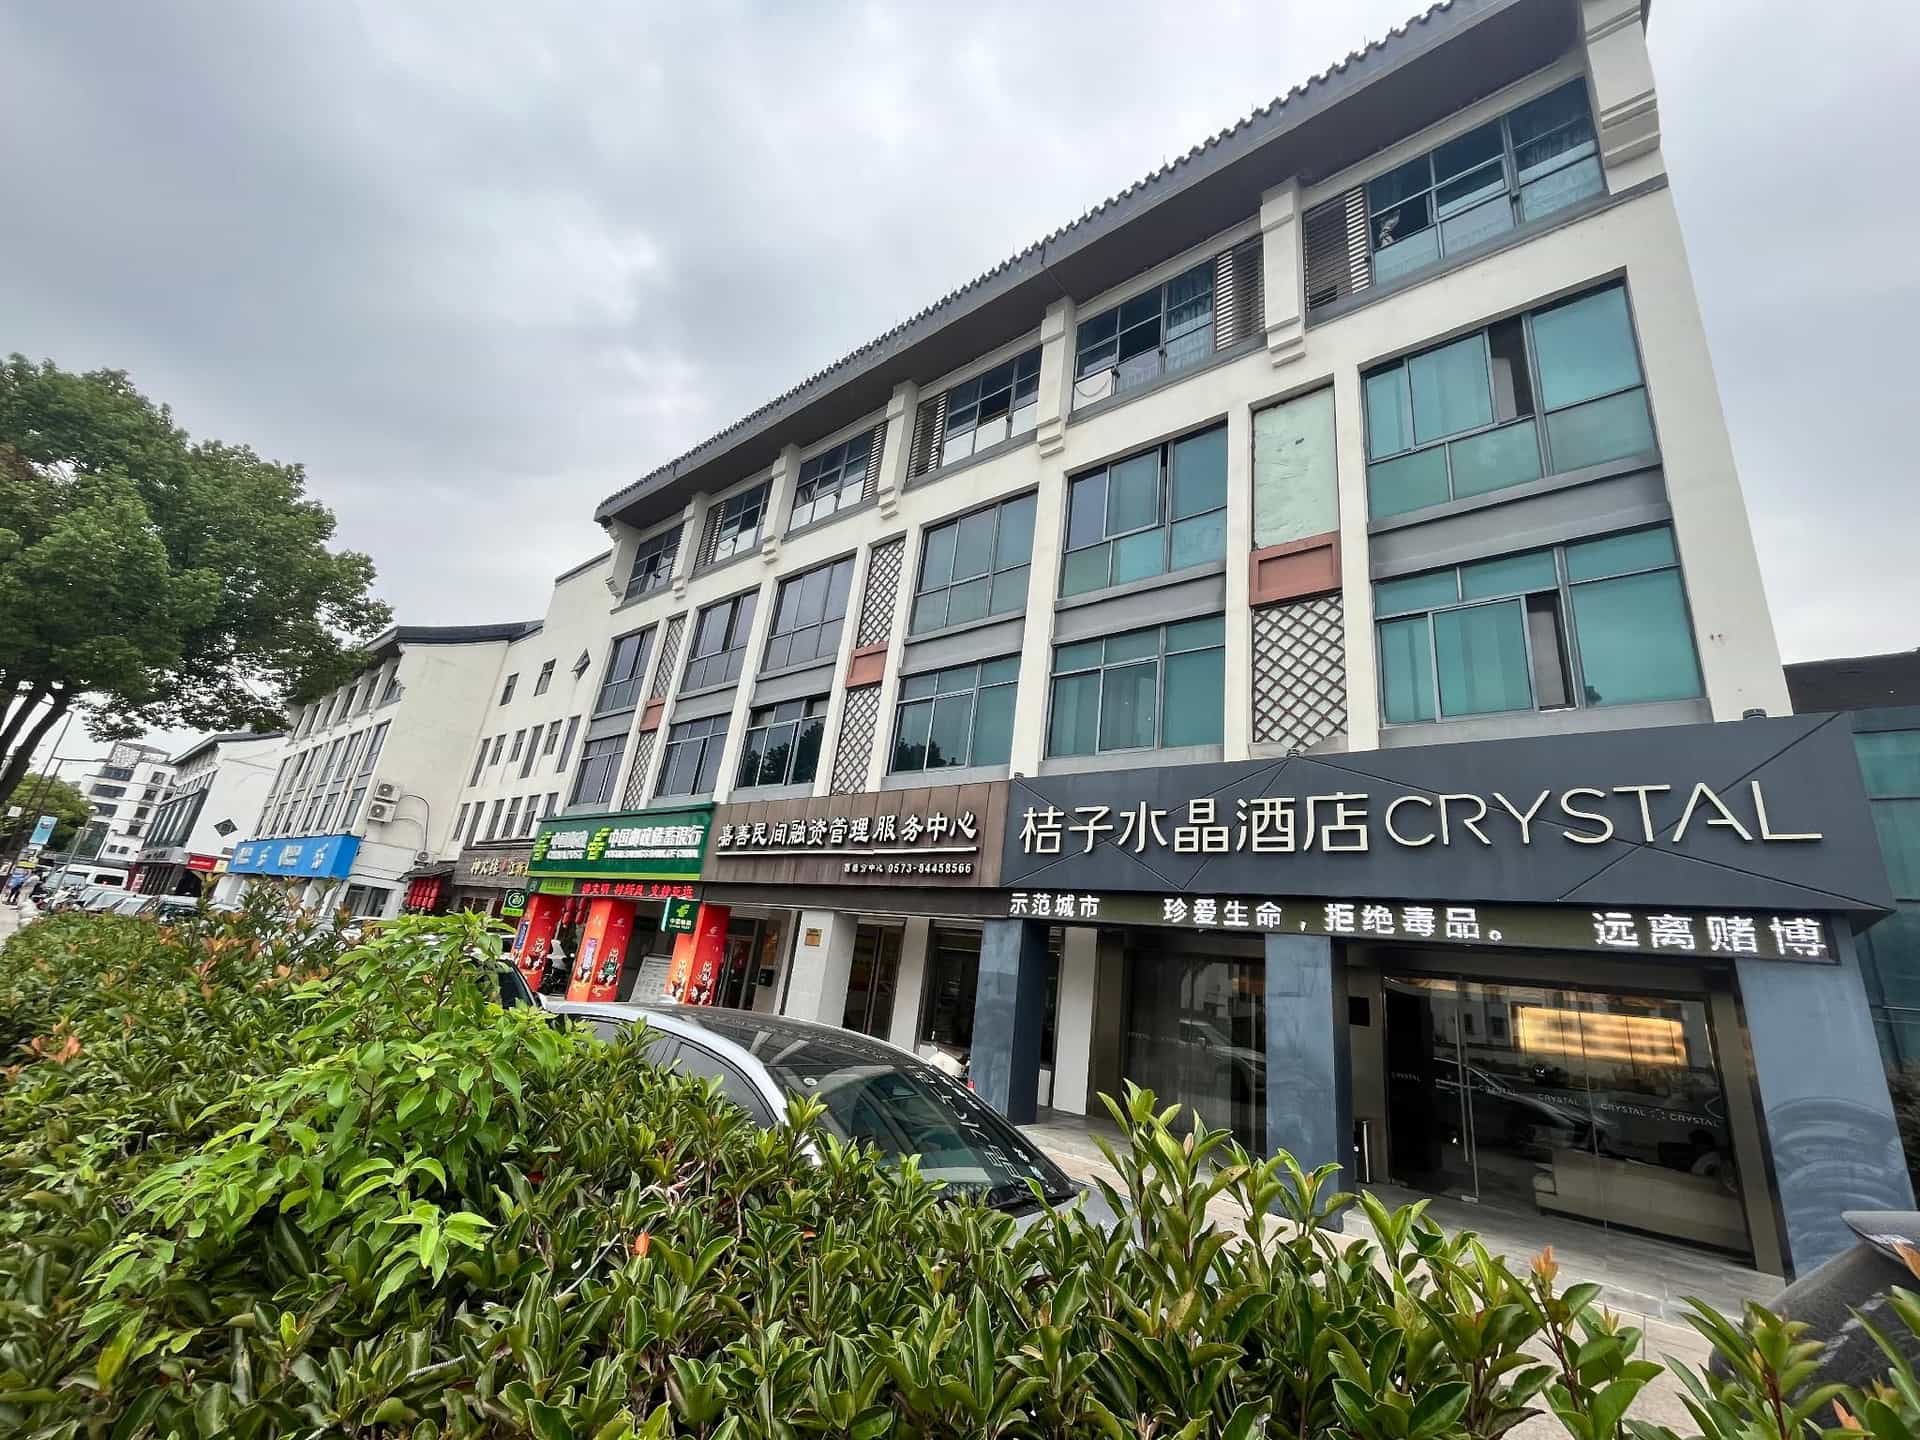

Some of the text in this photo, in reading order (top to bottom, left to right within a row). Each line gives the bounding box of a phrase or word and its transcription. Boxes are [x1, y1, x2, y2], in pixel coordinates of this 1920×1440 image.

[718, 811, 977, 848] 嘉善民间融资管理服务中心
[1019, 780, 1823, 854] 桔子水晶酒店 CRYSTAL
[1009, 893, 1101, 919] 示范城市
[1592, 911, 1826, 957] 远离赌博
